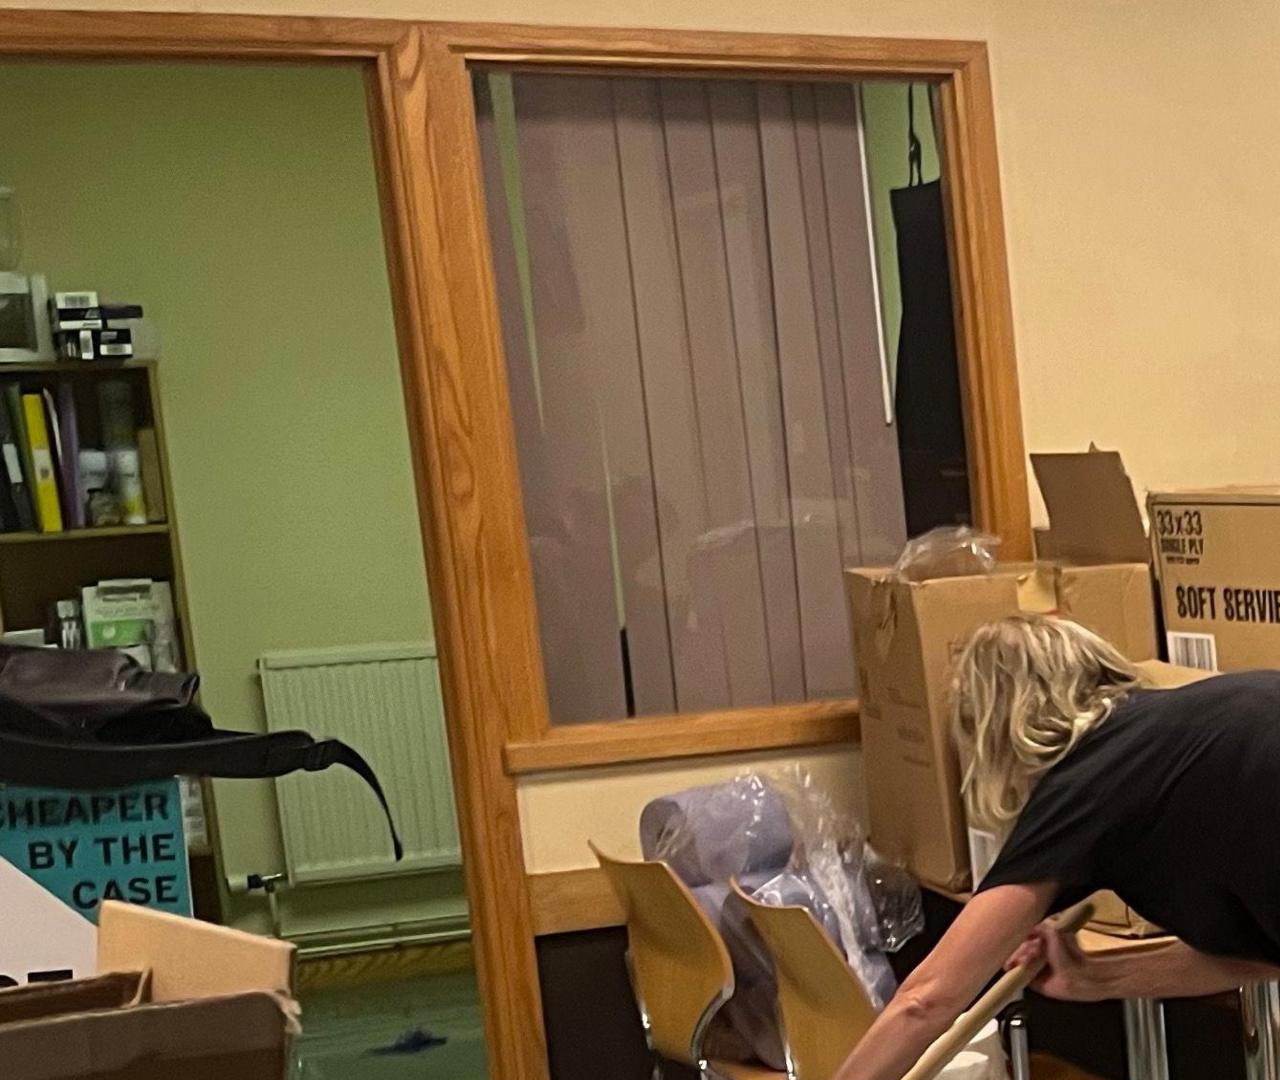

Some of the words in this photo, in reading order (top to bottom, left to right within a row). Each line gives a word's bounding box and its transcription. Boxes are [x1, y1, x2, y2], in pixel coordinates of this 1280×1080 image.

[1176, 584, 1216, 620] SOFT
[28, 840, 78, 869] BY
[94, 833, 176, 865] THE
[72, 875, 178, 909] CASE
